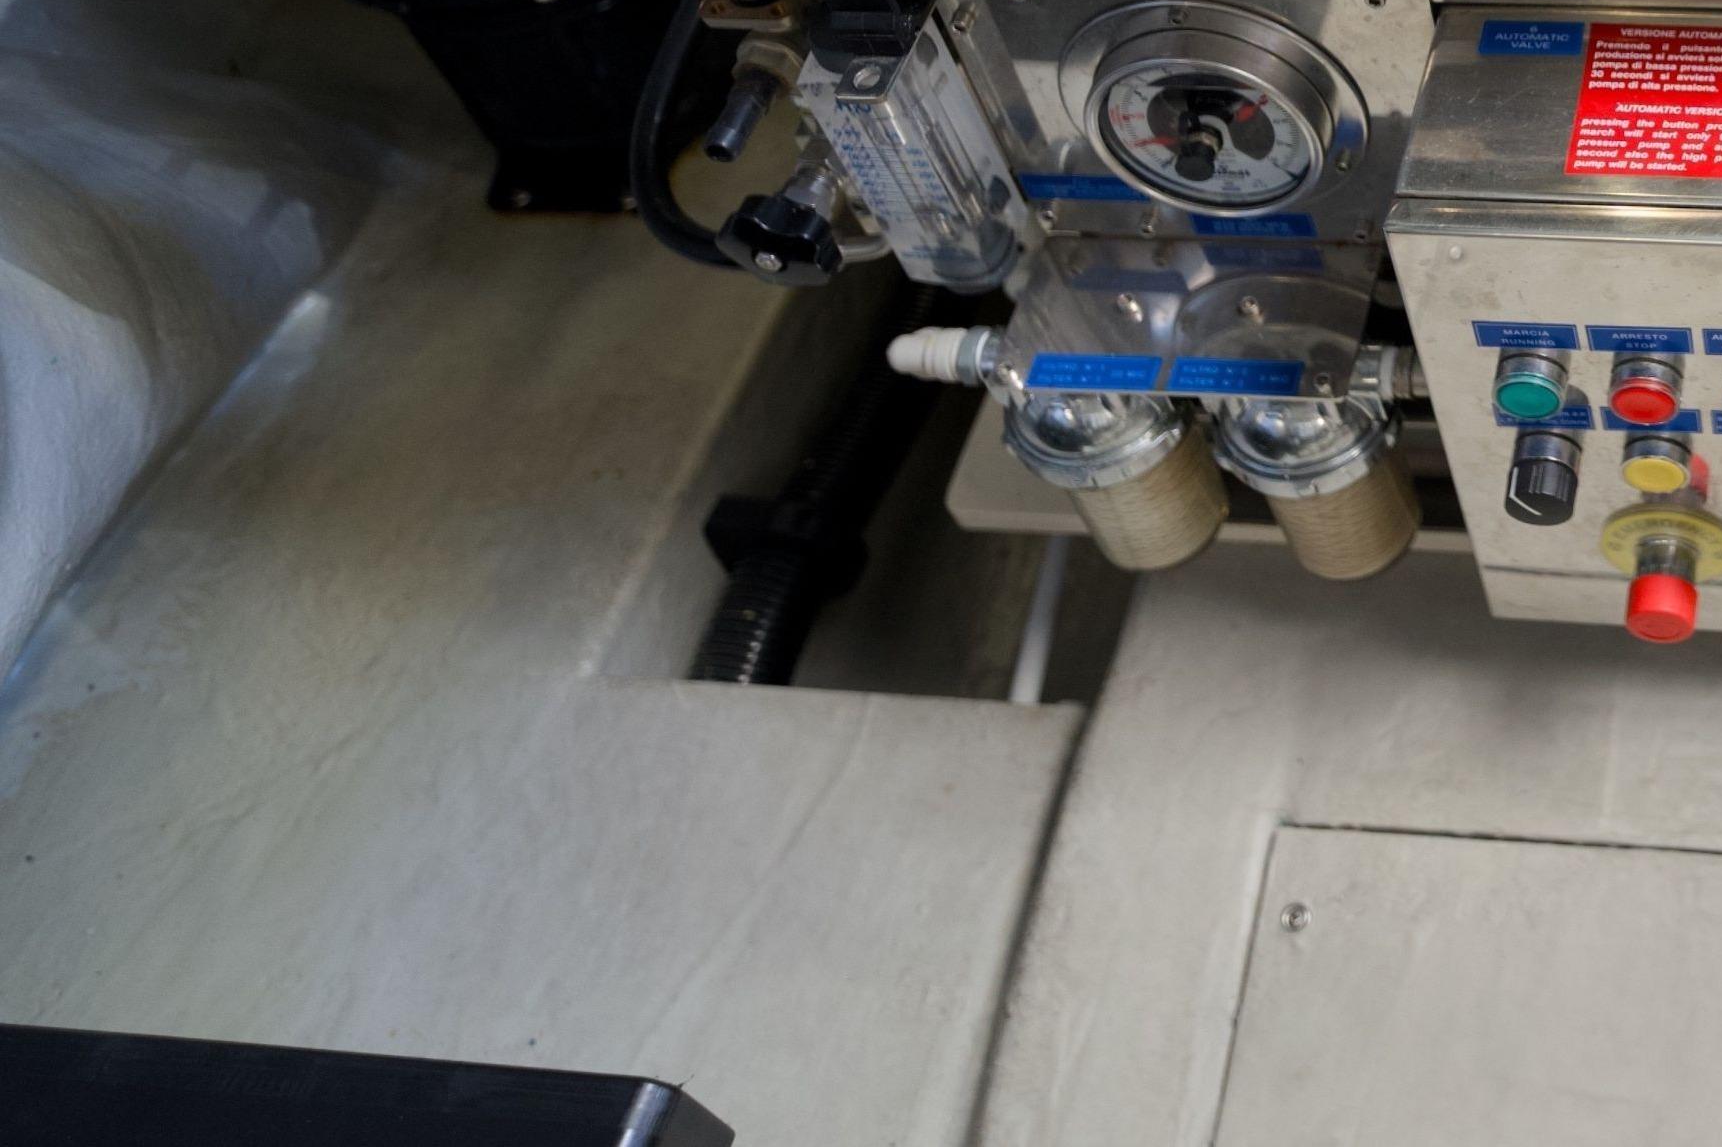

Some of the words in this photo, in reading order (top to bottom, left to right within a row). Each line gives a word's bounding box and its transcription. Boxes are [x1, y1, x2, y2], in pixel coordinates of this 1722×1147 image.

[1494, 33, 1569, 42] AUTOMATIC
[1620, 28, 1676, 38] VERSIONE
[1511, 41, 1551, 49] VALVE
[1595, 40, 1651, 50] Premendo
[1594, 51, 1652, 62] produzione
[1655, 52, 1665, 61] si
[1592, 60, 1629, 71] pompa
[1631, 61, 1642, 70] di
[1645, 62, 1677, 71] bassa
[1590, 69, 1604, 78] 30
[1611, 70, 1653, 80] secondi
[1660, 71, 1670, 80] si
[1588, 80, 1625, 90] pompa
[1627, 80, 1638, 90] di
[1640, 81, 1661, 91] alta
[1662, 82, 1719, 93] pressione.
[1615, 104, 1681, 114] AUTOMATIC
[1581, 117, 1630, 129] pressing
[1636, 118, 1655, 128] the
[1662, 119, 1699, 130] button
[1579, 127, 1615, 137] march
[1624, 128, 1643, 138] will
[1652, 130, 1678, 139] start
[1686, 131, 1711, 142] only
[1577, 139, 1627, 149] pressure
[1637, 141, 1670, 151] pump
[1681, 141, 1704, 151] and
[1576, 148, 1618, 158] second
[1624, 150, 1649, 159] also
[1655, 151, 1675, 160] the
[1681, 152, 1708, 163] high
[1573, 159, 1606, 169] pump
[1608, 159, 1628, 169] will
[1629, 159, 1644, 170] be
[1647, 161, 1688, 172] started.
[1502, 329, 1549, 338] MARCIA
[1612, 332, 1668, 341] ARRESTO
[1500, 338, 1556, 347] RUNNING
[1626, 342, 1657, 350] STOP
